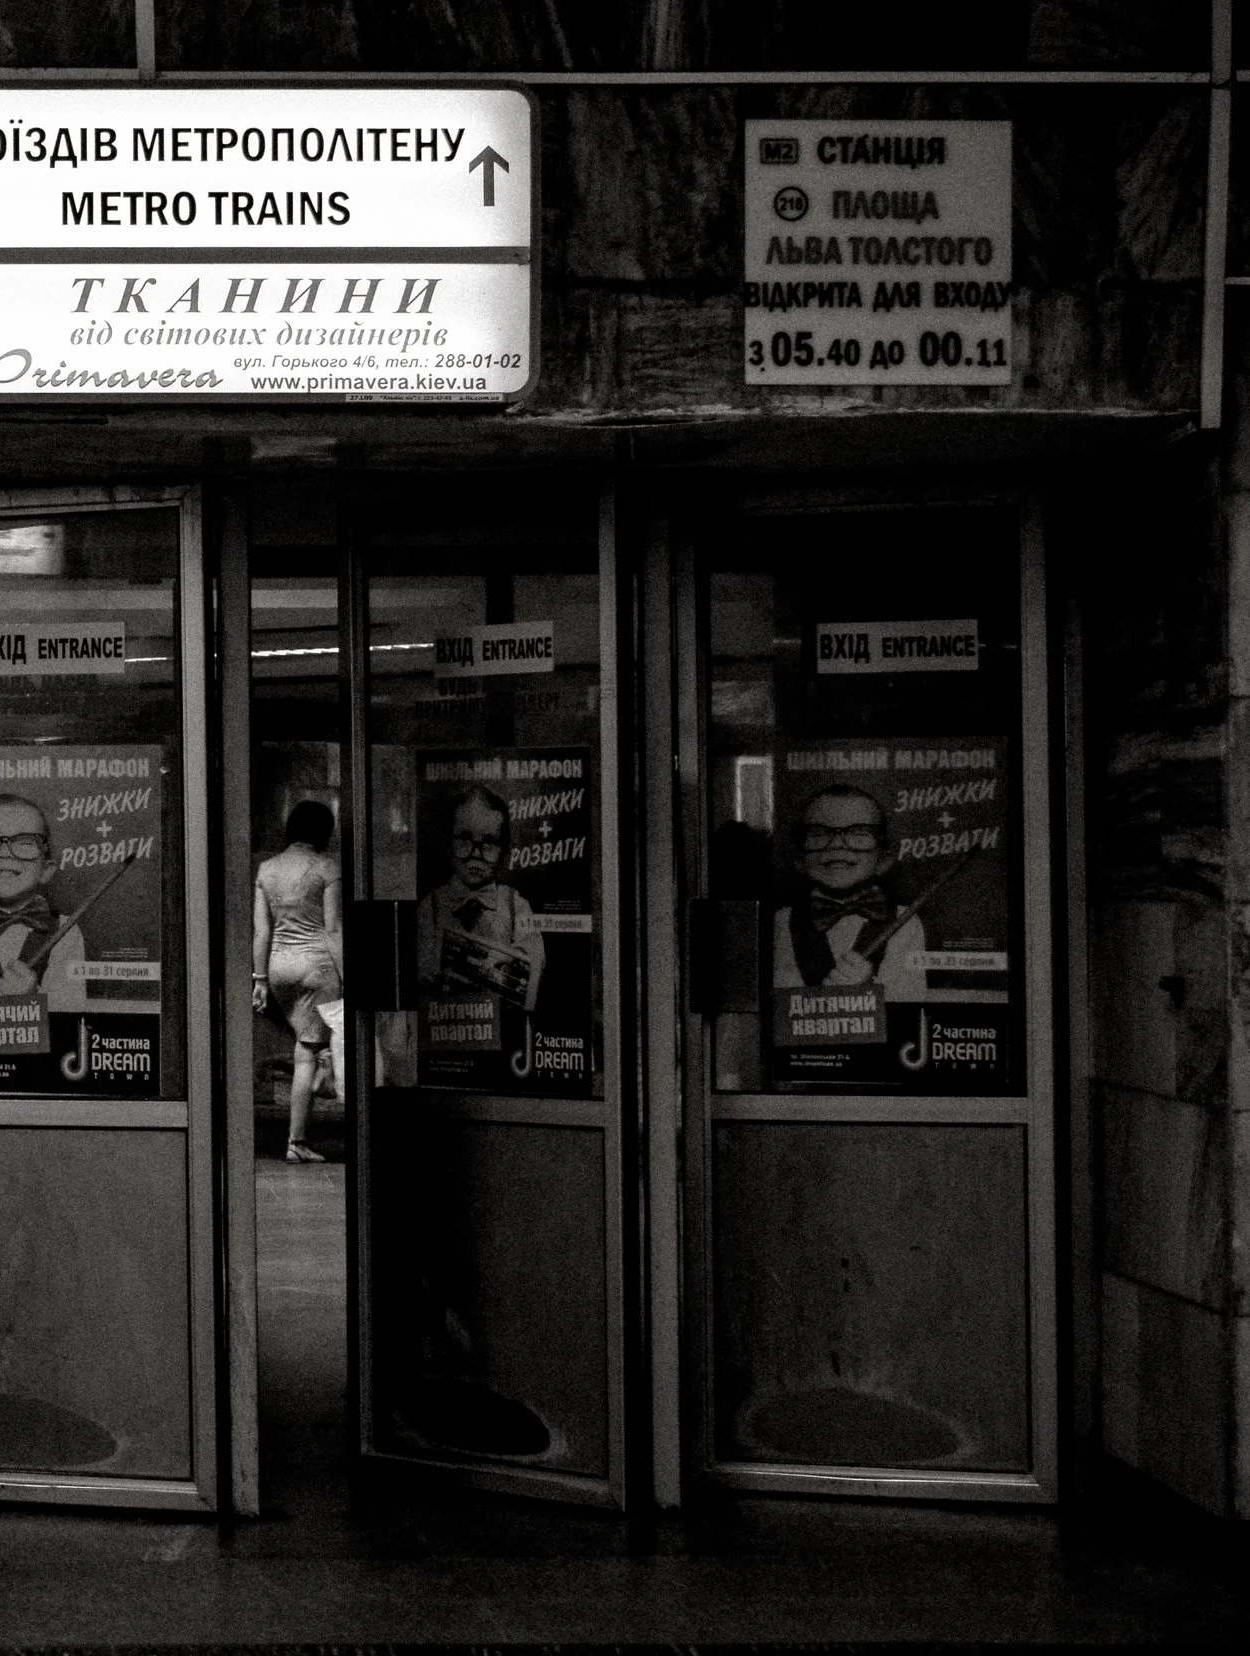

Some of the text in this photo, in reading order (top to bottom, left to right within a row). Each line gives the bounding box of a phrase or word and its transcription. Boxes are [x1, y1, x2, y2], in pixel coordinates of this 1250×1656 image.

[132, 126, 466, 163] МЕТРОПОЛІТЕНУ
[816, 136, 945, 169] СТАНЦІЯ
[62, 190, 351, 226] METRO TRAINS
[780, 197, 803, 211] 218
[832, 190, 940, 224] ПЛОЩА
[765, 236, 992, 265] ЛЬВА ТОЛСТОГО
[70, 277, 443, 314] ТКАНИНИ
[745, 281, 1011, 313] ВІДКРИТА ДЛЯ ВХОДУ
[70, 320, 448, 353] від світових дизайнерів
[771, 331, 860, 366] 05.40
[919, 331, 1007, 367] 00.11
[233, 353, 521, 370] вул. Горького 4/6, тел.: 288-01-02
[251, 374, 487, 392] www.primavera.kiev.ua
[38, 637, 123, 659] ENTRANCE
[436, 637, 552, 667] ВХІД ENTRANCE
[820, 634, 975, 663] ВХІД ENTRANCE
[57, 757, 149, 778] МАРАФОН
[506, 758, 583, 779] МАРАФОН
[895, 750, 996, 770] МАРАФОН
[56, 787, 152, 822] ЗНИЖКИ
[509, 788, 585, 821] ЗНИЖКИ
[894, 778, 998, 813] ЗНИЖКИ
[60, 836, 154, 871] РОЗВАГИ
[509, 836, 586, 870] РОЗВАГИ
[899, 827, 1000, 861] РОЗВАГИ
[789, 990, 876, 1017] Дитячий
[91, 1033, 150, 1050] 2 частина
[535, 1032, 584, 1049] 2 частина
[792, 1017, 876, 1037] квартал
[932, 1023, 997, 1040] 2 частина
[91, 1052, 151, 1072] DREAM
[535, 1051, 585, 1070] DREAM
[932, 1042, 997, 1061] DREAM
